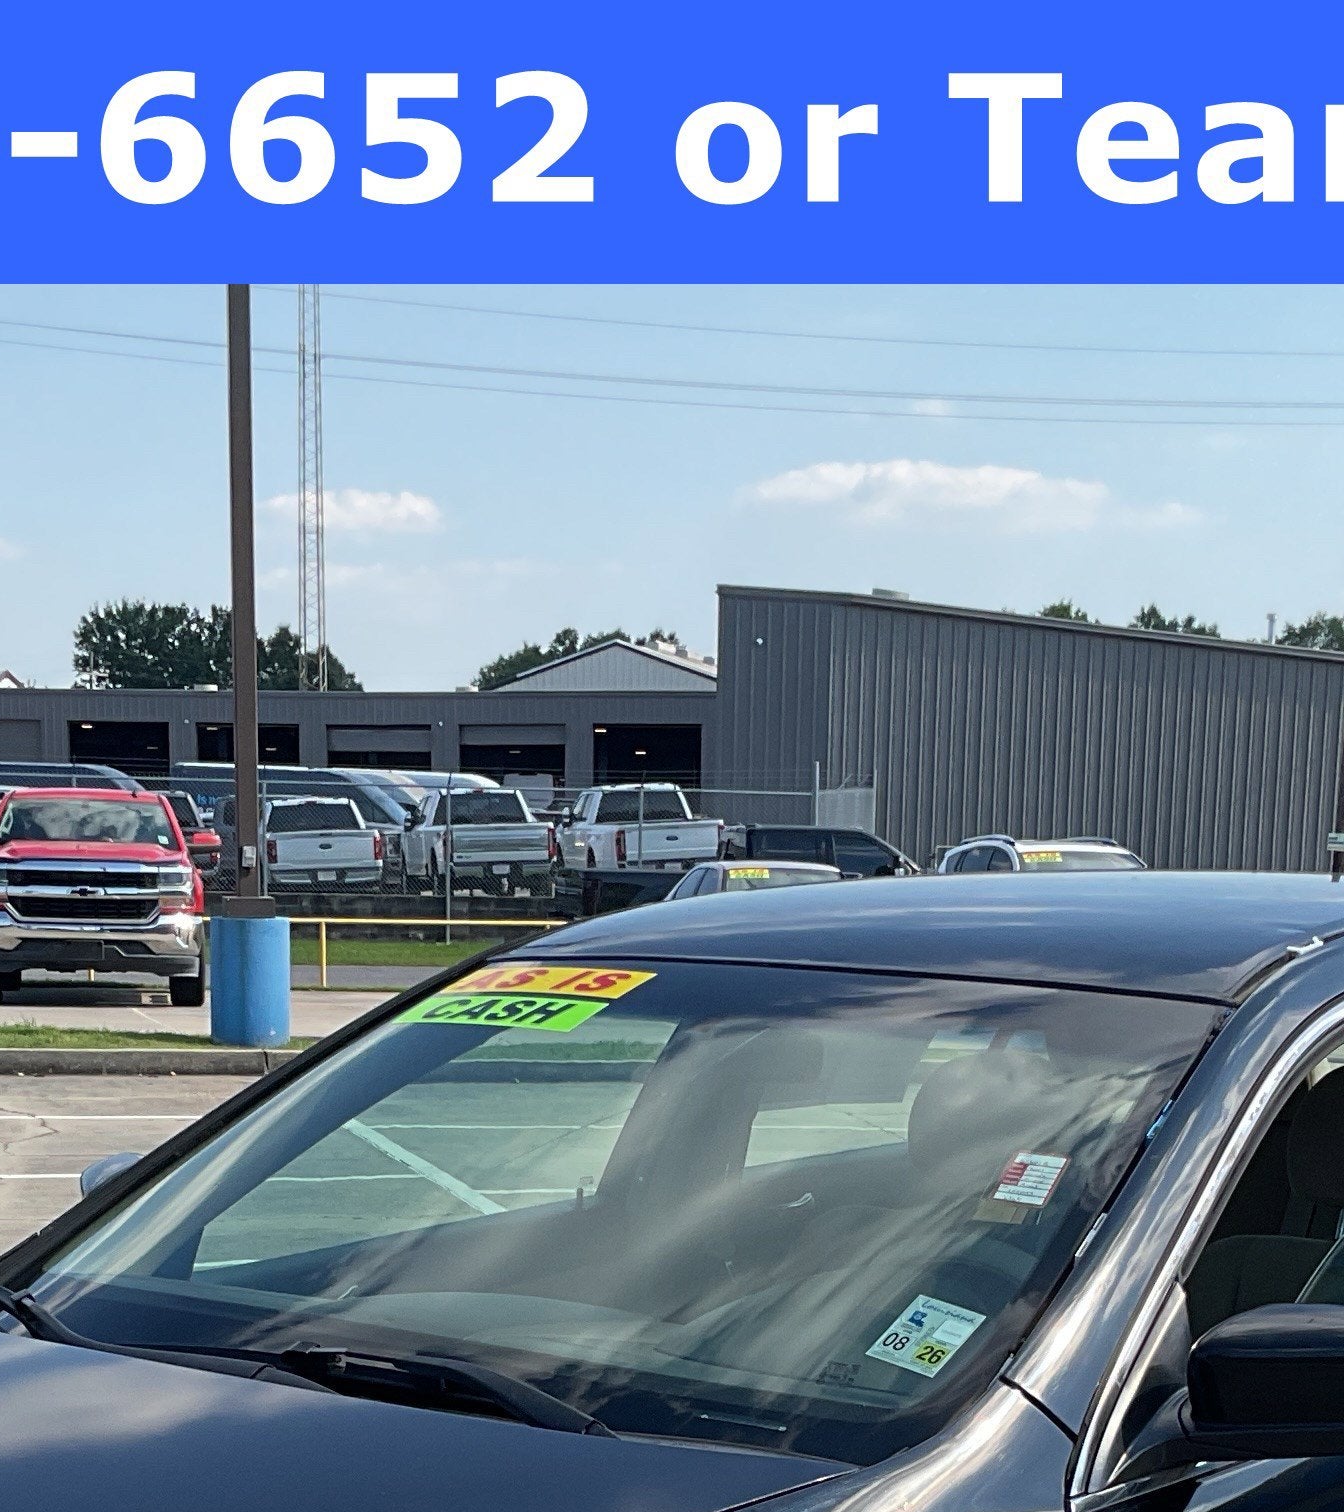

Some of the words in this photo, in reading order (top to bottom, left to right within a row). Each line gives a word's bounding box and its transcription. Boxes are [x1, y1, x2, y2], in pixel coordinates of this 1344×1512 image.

[458, 969, 550, 990] AS
[549, 970, 632, 992] IS
[421, 999, 578, 1024] CASH
[882, 1332, 910, 1351] 08
[916, 1345, 946, 1365] 26
